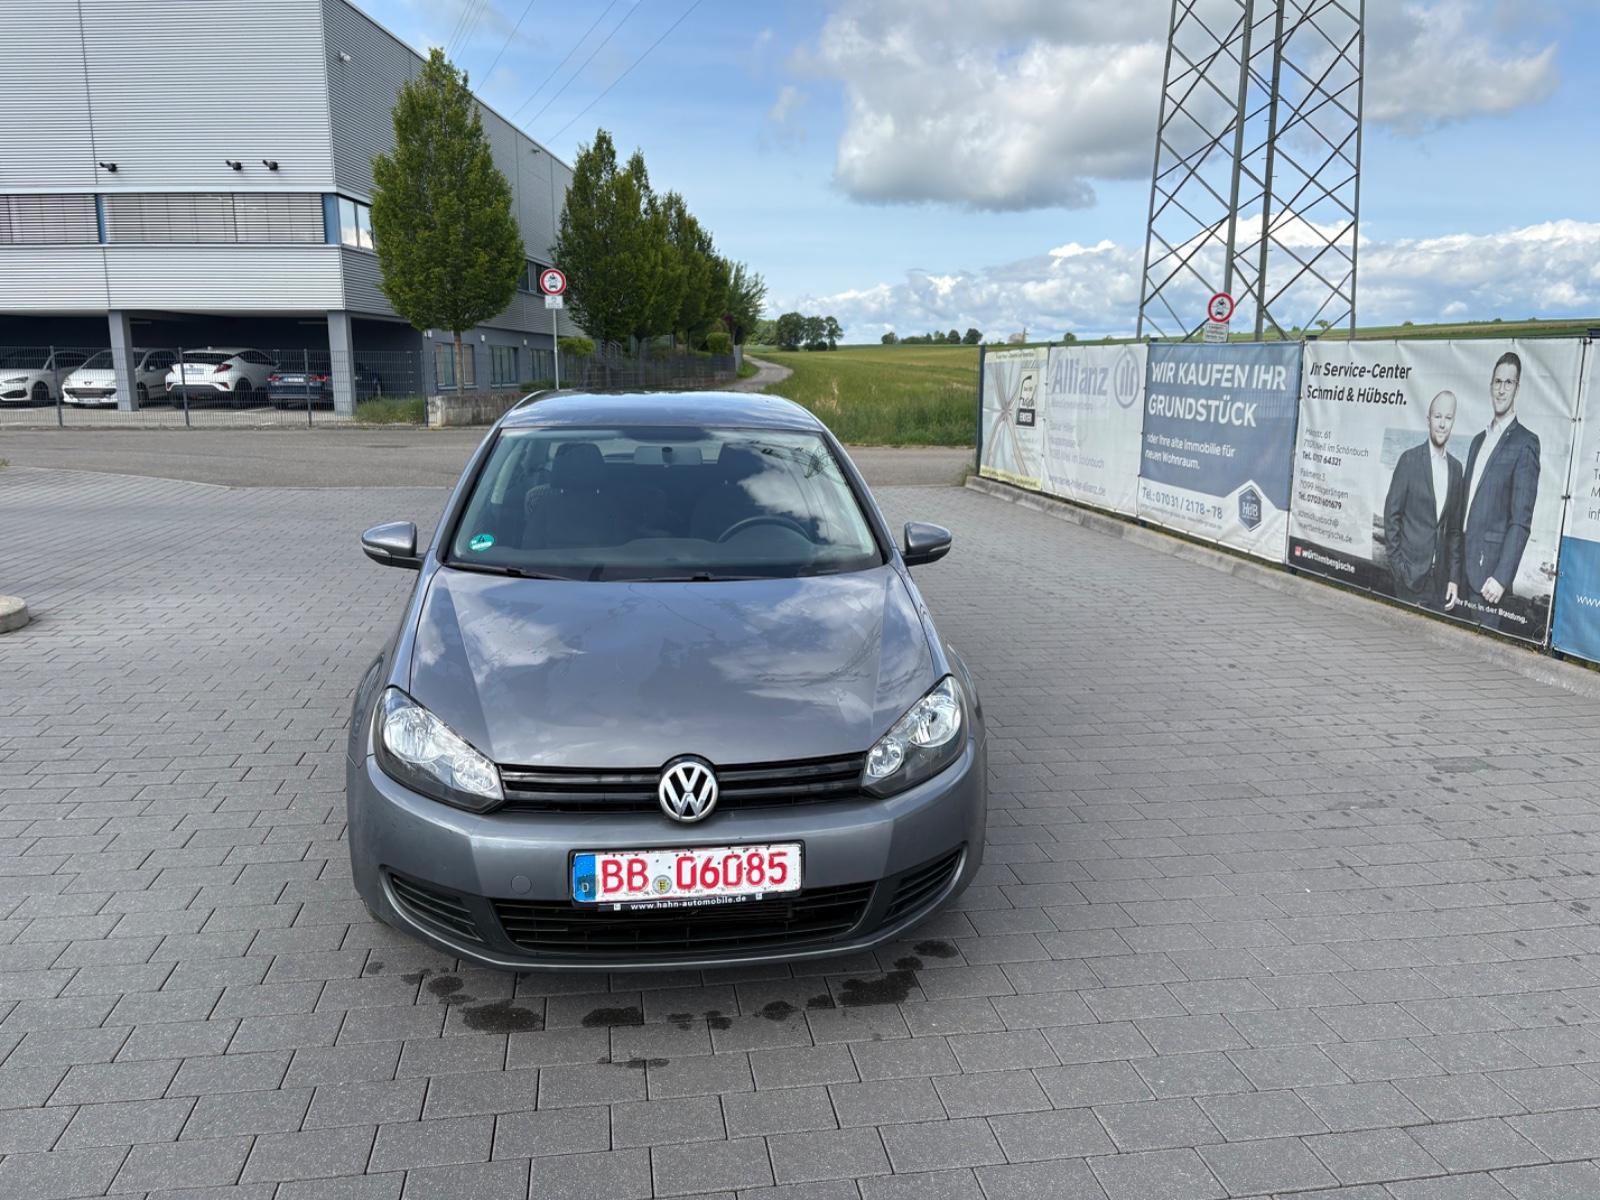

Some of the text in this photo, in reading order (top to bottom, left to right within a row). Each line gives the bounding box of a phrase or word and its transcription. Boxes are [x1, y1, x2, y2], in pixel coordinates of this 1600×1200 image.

[1051, 358, 1109, 396] Allianz
[1151, 362, 1287, 391] WIR KAUFEN IHR
[1323, 362, 1412, 379] Service-Center
[1307, 384, 1407, 406] Schmid & Hübsch.
[1148, 394, 1258, 427] GRUNDSTÜCK
[1171, 437, 1184, 449] alte
[1184, 439, 1222, 456] Immobilie
[1222, 444, 1236, 457] für
[1162, 451, 1200, 470] Wohnraum.
[1155, 491, 1179, 508] 07031
[602, 851, 788, 893] BB 06085
[630, 896, 747, 910] www.hahn-automobile.de
